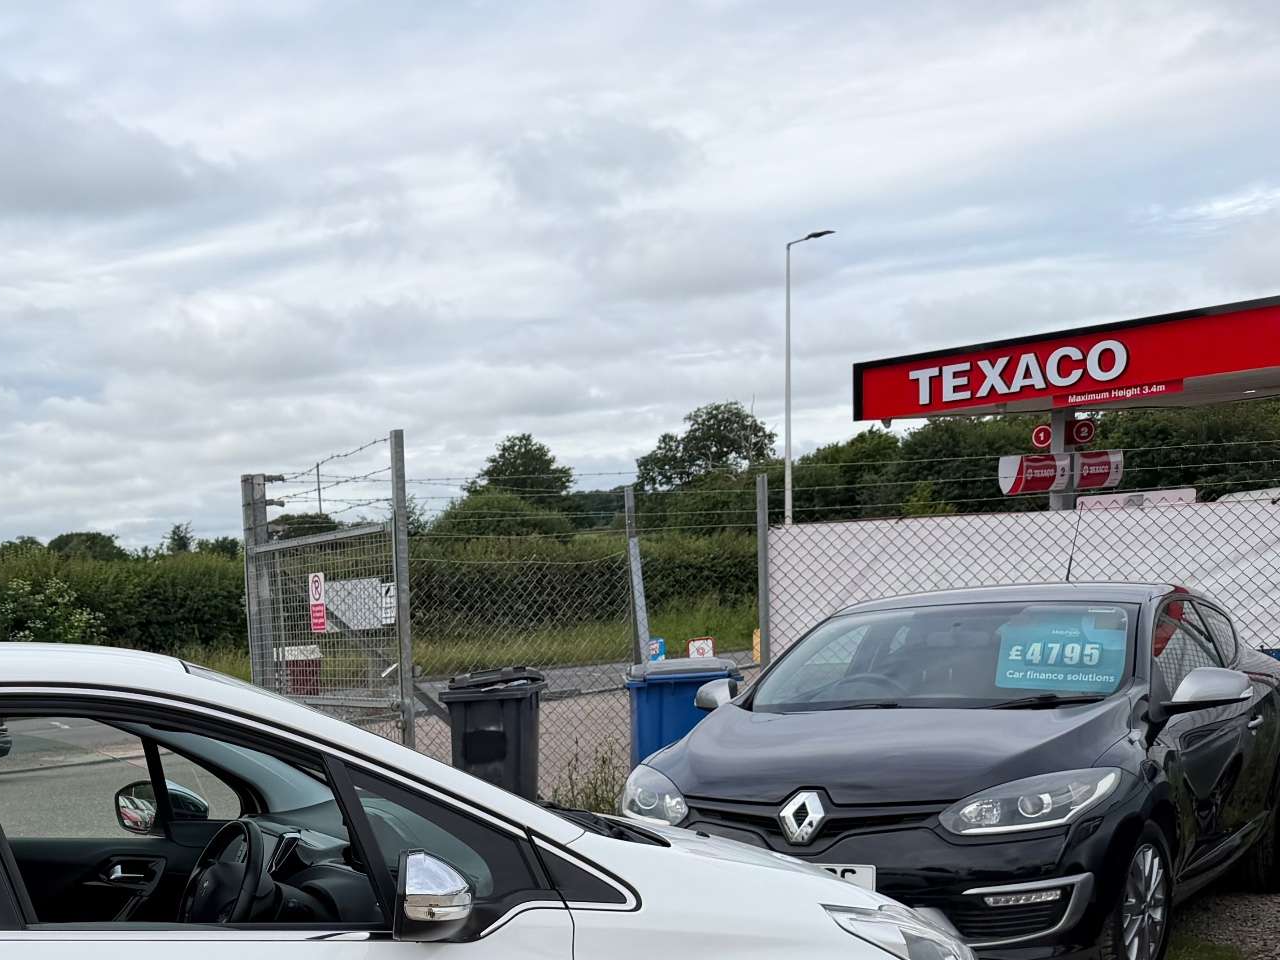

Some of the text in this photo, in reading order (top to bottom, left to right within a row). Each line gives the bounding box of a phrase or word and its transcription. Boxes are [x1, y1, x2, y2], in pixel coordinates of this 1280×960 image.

[909, 340, 1128, 405] TEXACO
[1068, 384, 1166, 404] Maximum Height 3.4m
[1081, 427, 1088, 436] 2
[1008, 643, 1099, 665] £4795
[1006, 670, 1115, 683] Car finance solutions
